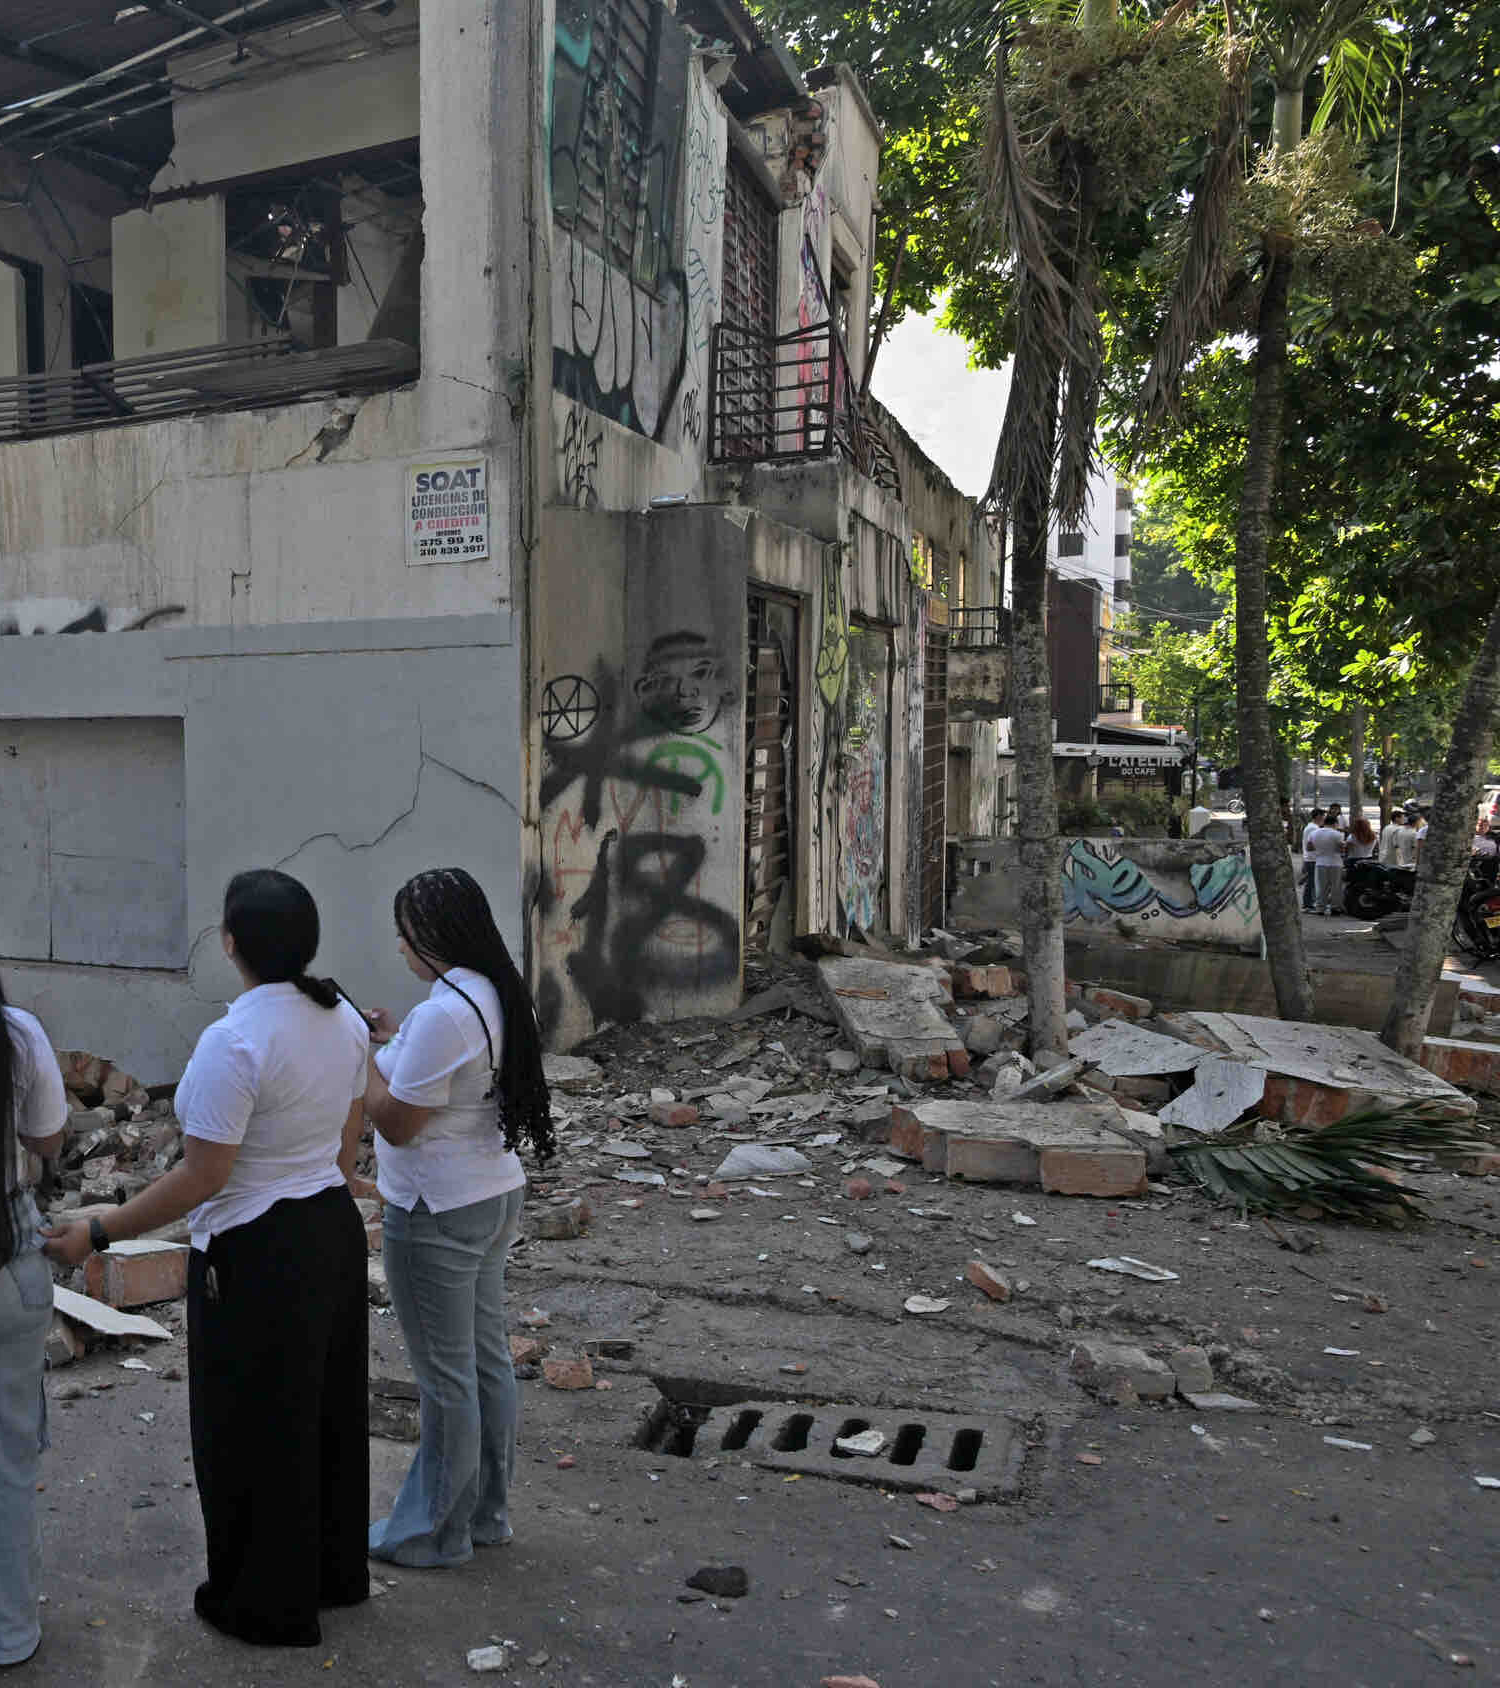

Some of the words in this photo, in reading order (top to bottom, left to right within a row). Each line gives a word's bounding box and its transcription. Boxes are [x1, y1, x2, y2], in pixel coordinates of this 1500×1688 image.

[416, 468, 481, 493] SOAT
[414, 520, 422, 531] A
[428, 516, 480, 529] CREDITO
[420, 538, 443, 547] 375
[420, 547, 437, 556] 310
[1108, 757, 1182, 767] L'ATELIER
